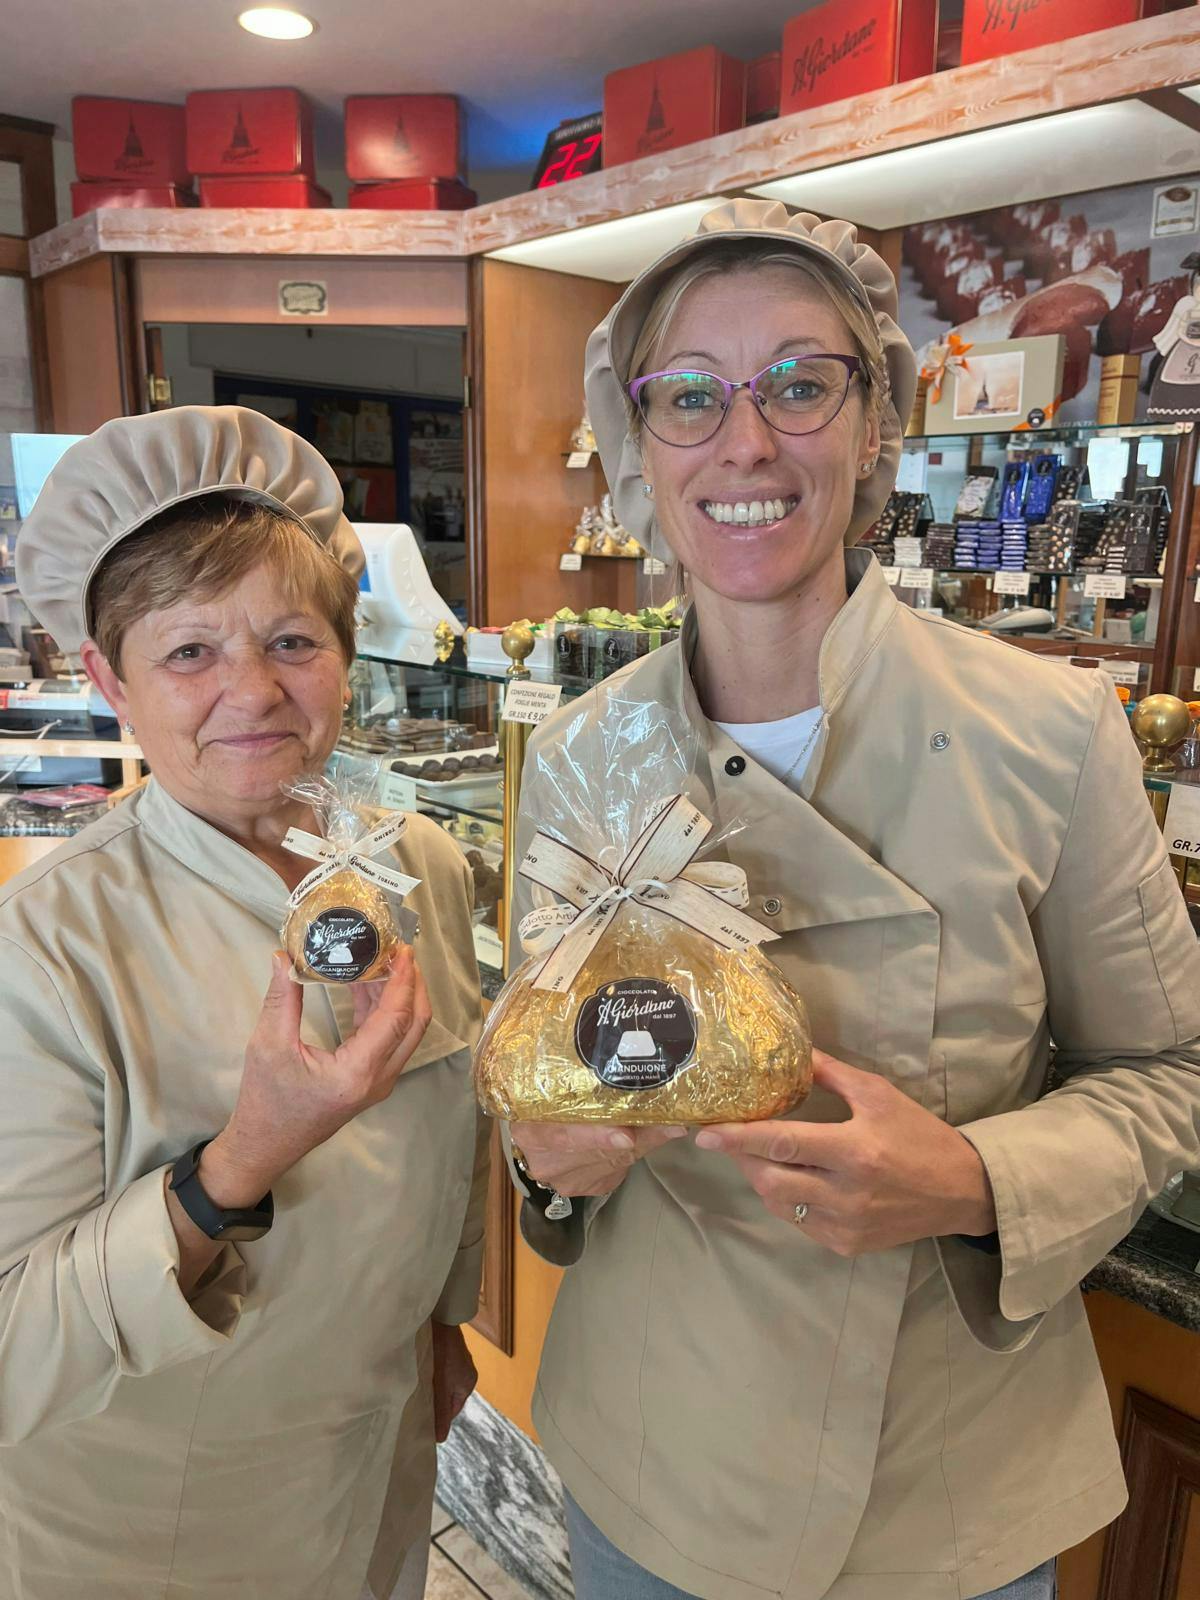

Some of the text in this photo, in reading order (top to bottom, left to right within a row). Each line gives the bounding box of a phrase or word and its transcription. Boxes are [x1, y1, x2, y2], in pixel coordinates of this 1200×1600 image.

[377, 875, 399, 888] TORINO
[732, 931, 751, 945] 1897
[662, 1012, 677, 1020] 1897
